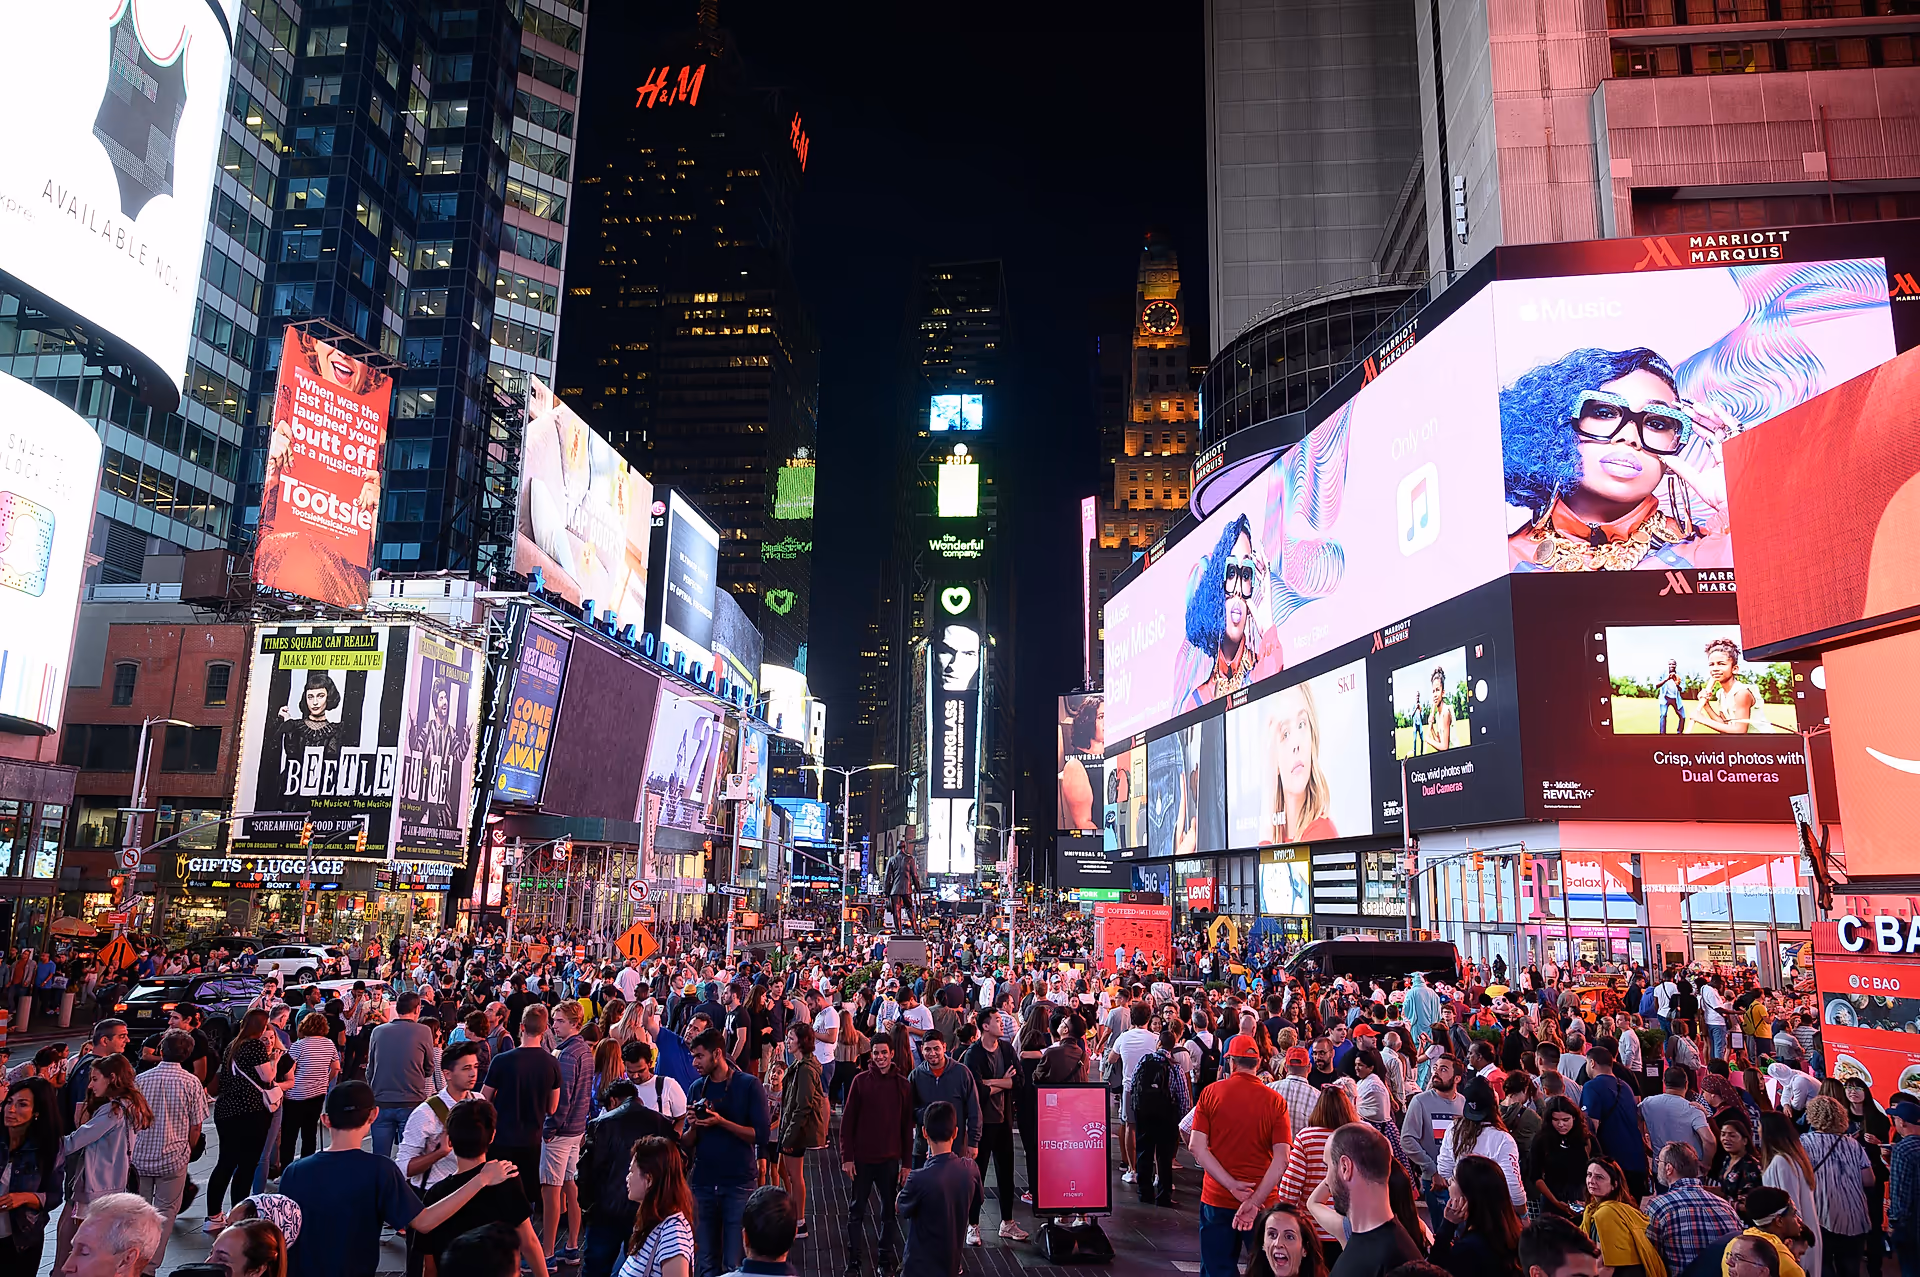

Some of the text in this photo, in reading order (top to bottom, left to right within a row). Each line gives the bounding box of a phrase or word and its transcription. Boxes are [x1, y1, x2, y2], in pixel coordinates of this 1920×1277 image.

[636, 64, 706, 108] H&M
[42, 179, 147, 265] AVAILABLE
[1690, 231, 1790, 247] MARRIOTT
[1691, 247, 1780, 263] MARQUIS
[1543, 298, 1622, 321] Music
[1380, 319, 1418, 358] MARRIOTT
[1381, 336, 1414, 371] MARQUIS
[295, 387, 379, 435] last time you
[337, 395, 359, 413] was
[361, 404, 379, 422] the
[293, 401, 377, 448] laughed your
[291, 416, 376, 469] butt off
[293, 442, 306, 456] at
[308, 448, 316, 459] a
[280, 473, 372, 531] Tootsie
[291, 506, 358, 536] TootsieMusical.com
[651, 518, 664, 527] LG
[929, 539, 984, 550] Wonderful
[943, 533, 956, 541] the
[264, 635, 376, 650] TIMES SQUARE CAN REALLY
[1107, 609, 1166, 673] New Music
[282, 655, 380, 666] MAKE YOU FEEL ALIVE!
[583, 599, 655, 657] 1540
[656, 640, 767, 719] BROADWAY
[1107, 669, 1132, 706] Daily
[514, 697, 553, 728] COME
[508, 719, 549, 751] FROM
[943, 699, 958, 790] HOURGLASS
[503, 743, 544, 772] AWAY
[1653, 751, 1805, 766] Crisp, vivid photos with
[284, 752, 393, 796] BEETLE
[1411, 761, 1474, 783] Crisp, vivid photos with
[1682, 770, 1780, 783] Dual Cameras
[1422, 782, 1463, 796] Dual Cameras
[311, 800, 391, 808] The The Musical
[252, 820, 304, 831] "SCREAMINGL
[188, 858, 344, 875] GIFTS LUGGAGE
[263, 873, 280, 882] NY
[417, 863, 454, 877] LUGGAGE
[1107, 907, 1136, 915] COFFEED
[1838, 915, 1865, 952] C
[1861, 976, 1900, 991] C BAO
[1082, 1122, 1106, 1133] FREE
